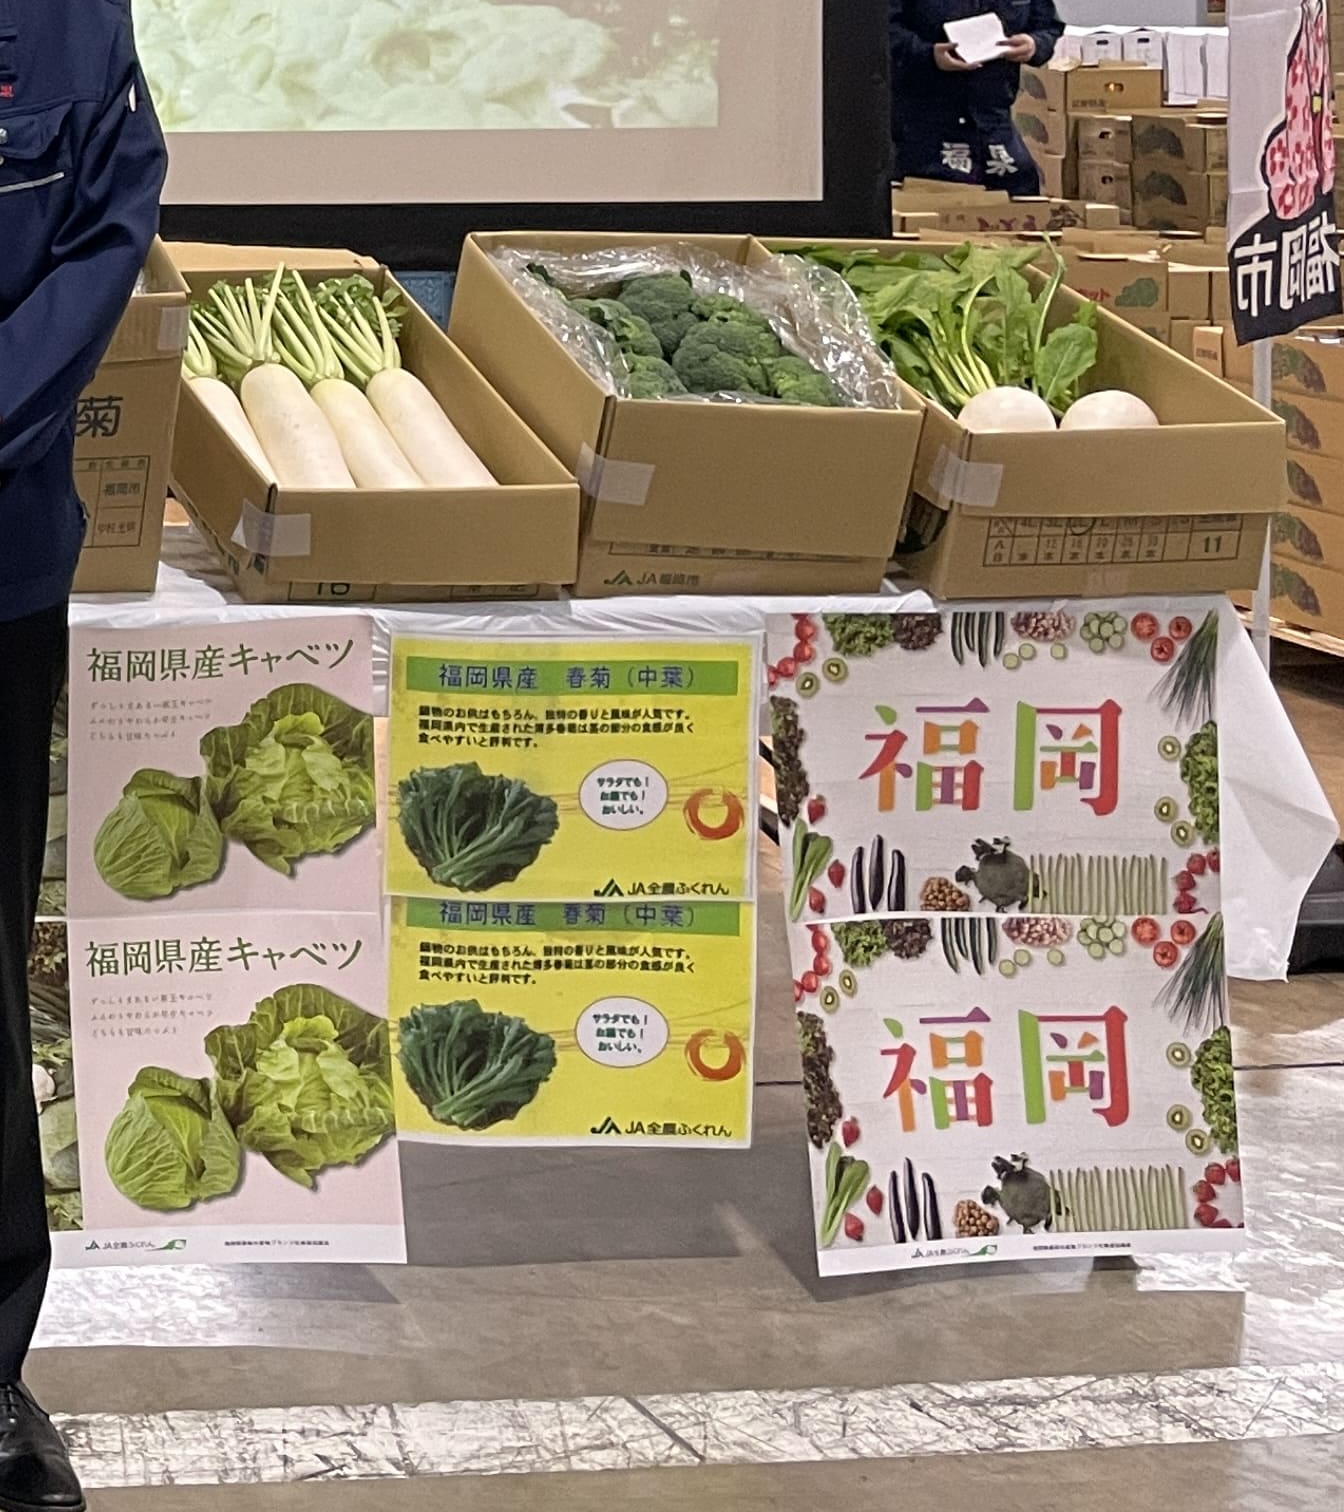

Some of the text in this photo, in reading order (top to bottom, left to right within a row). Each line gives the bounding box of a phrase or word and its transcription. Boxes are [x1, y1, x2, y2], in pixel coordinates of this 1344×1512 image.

[87, 638, 356, 684] 福岡県産キャベツ
[438, 664, 538, 690] 福岡県産
[858, 697, 1122, 816] 福岡
[439, 902, 537, 926] 福岡県産
[86, 936, 365, 978] 福岡県産キャベツ
[881, 1005, 1128, 1131] 福岡
